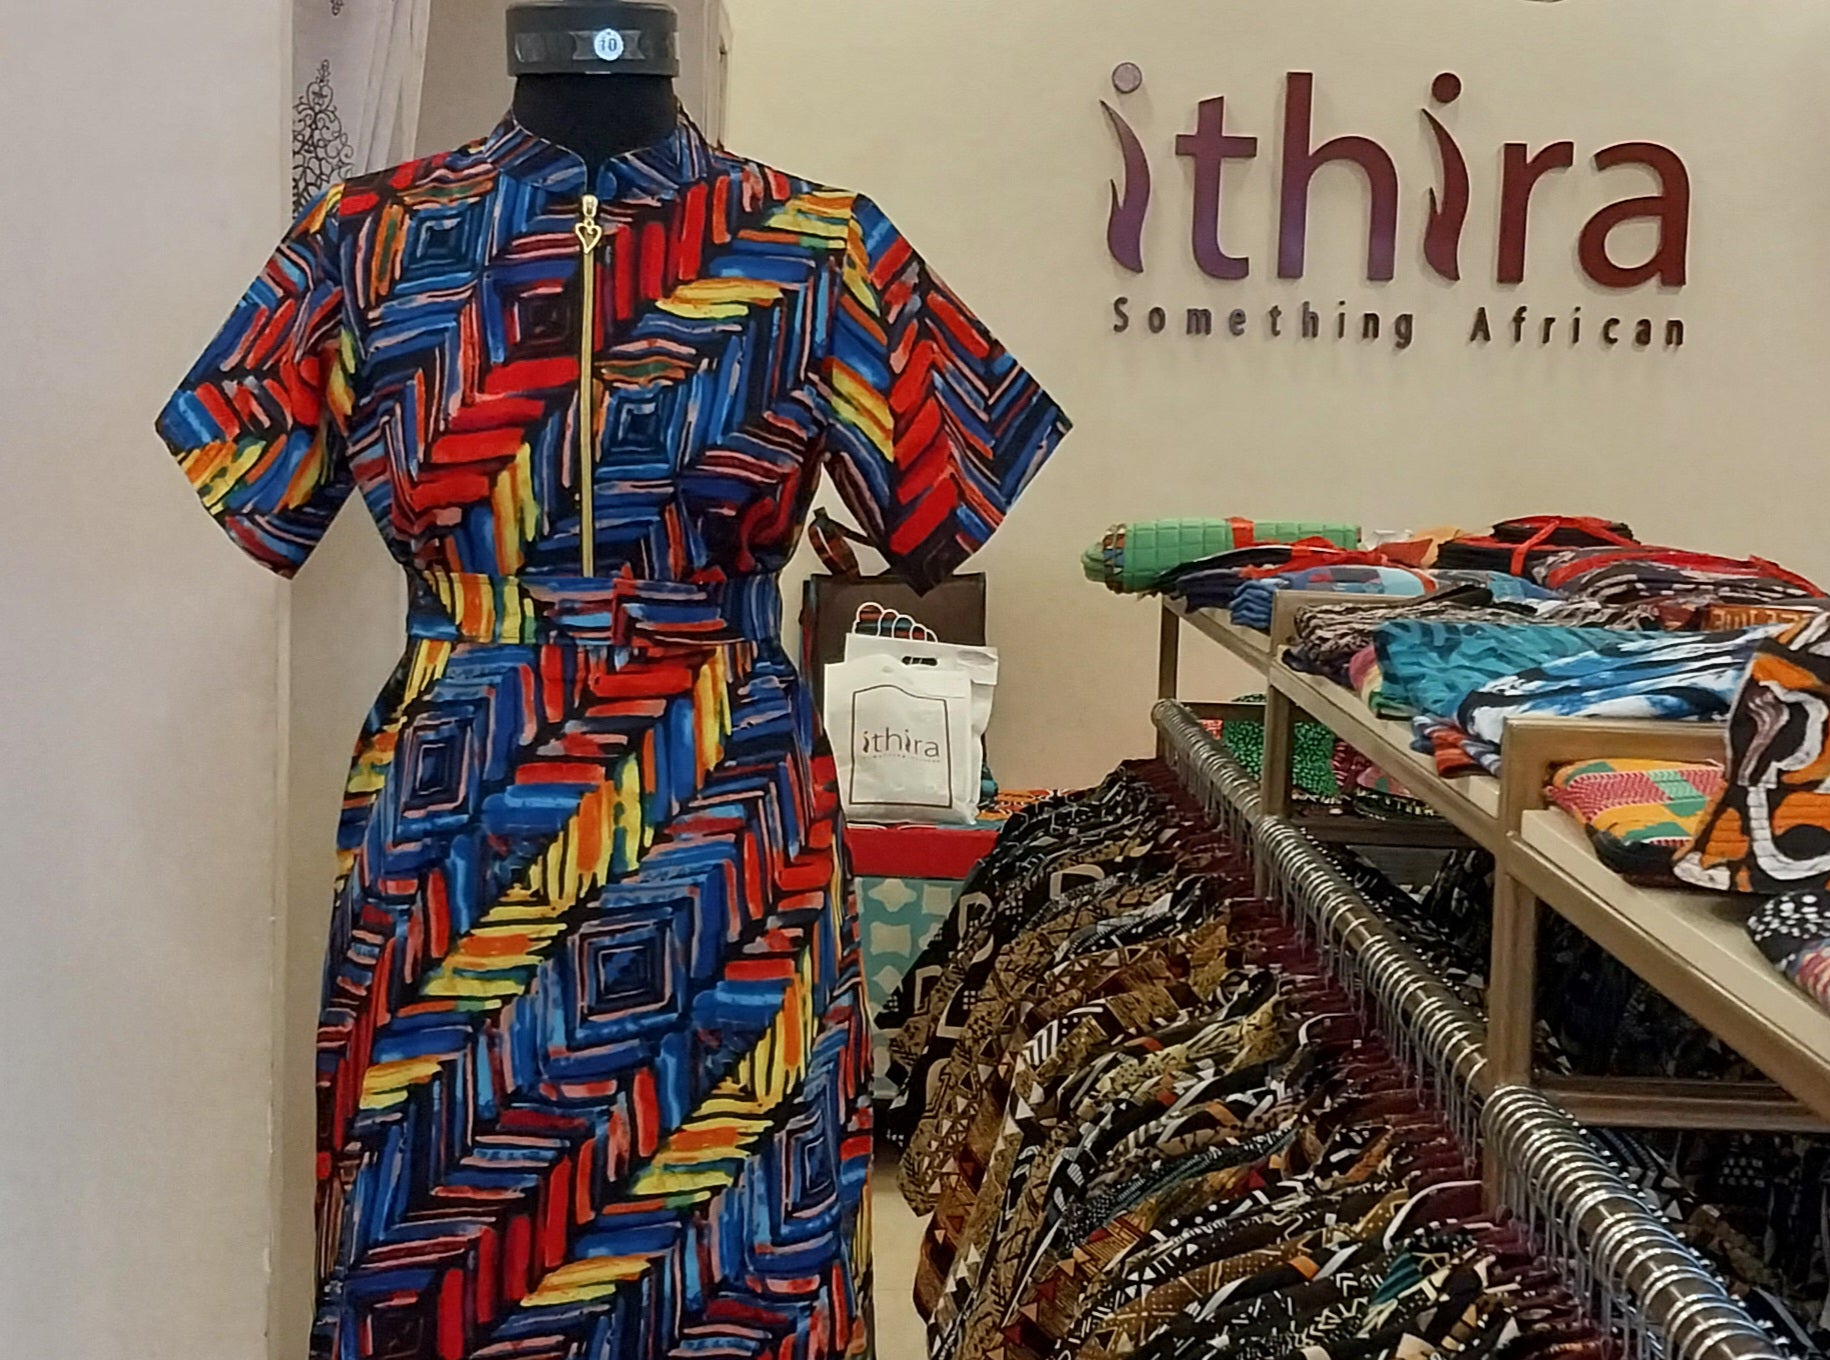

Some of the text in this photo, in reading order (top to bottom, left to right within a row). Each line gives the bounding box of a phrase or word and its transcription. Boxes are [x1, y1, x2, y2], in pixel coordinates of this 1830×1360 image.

[1100, 61, 1691, 289] ithira
[1112, 296, 1684, 349] Something African
[863, 727, 940, 758] ithira
